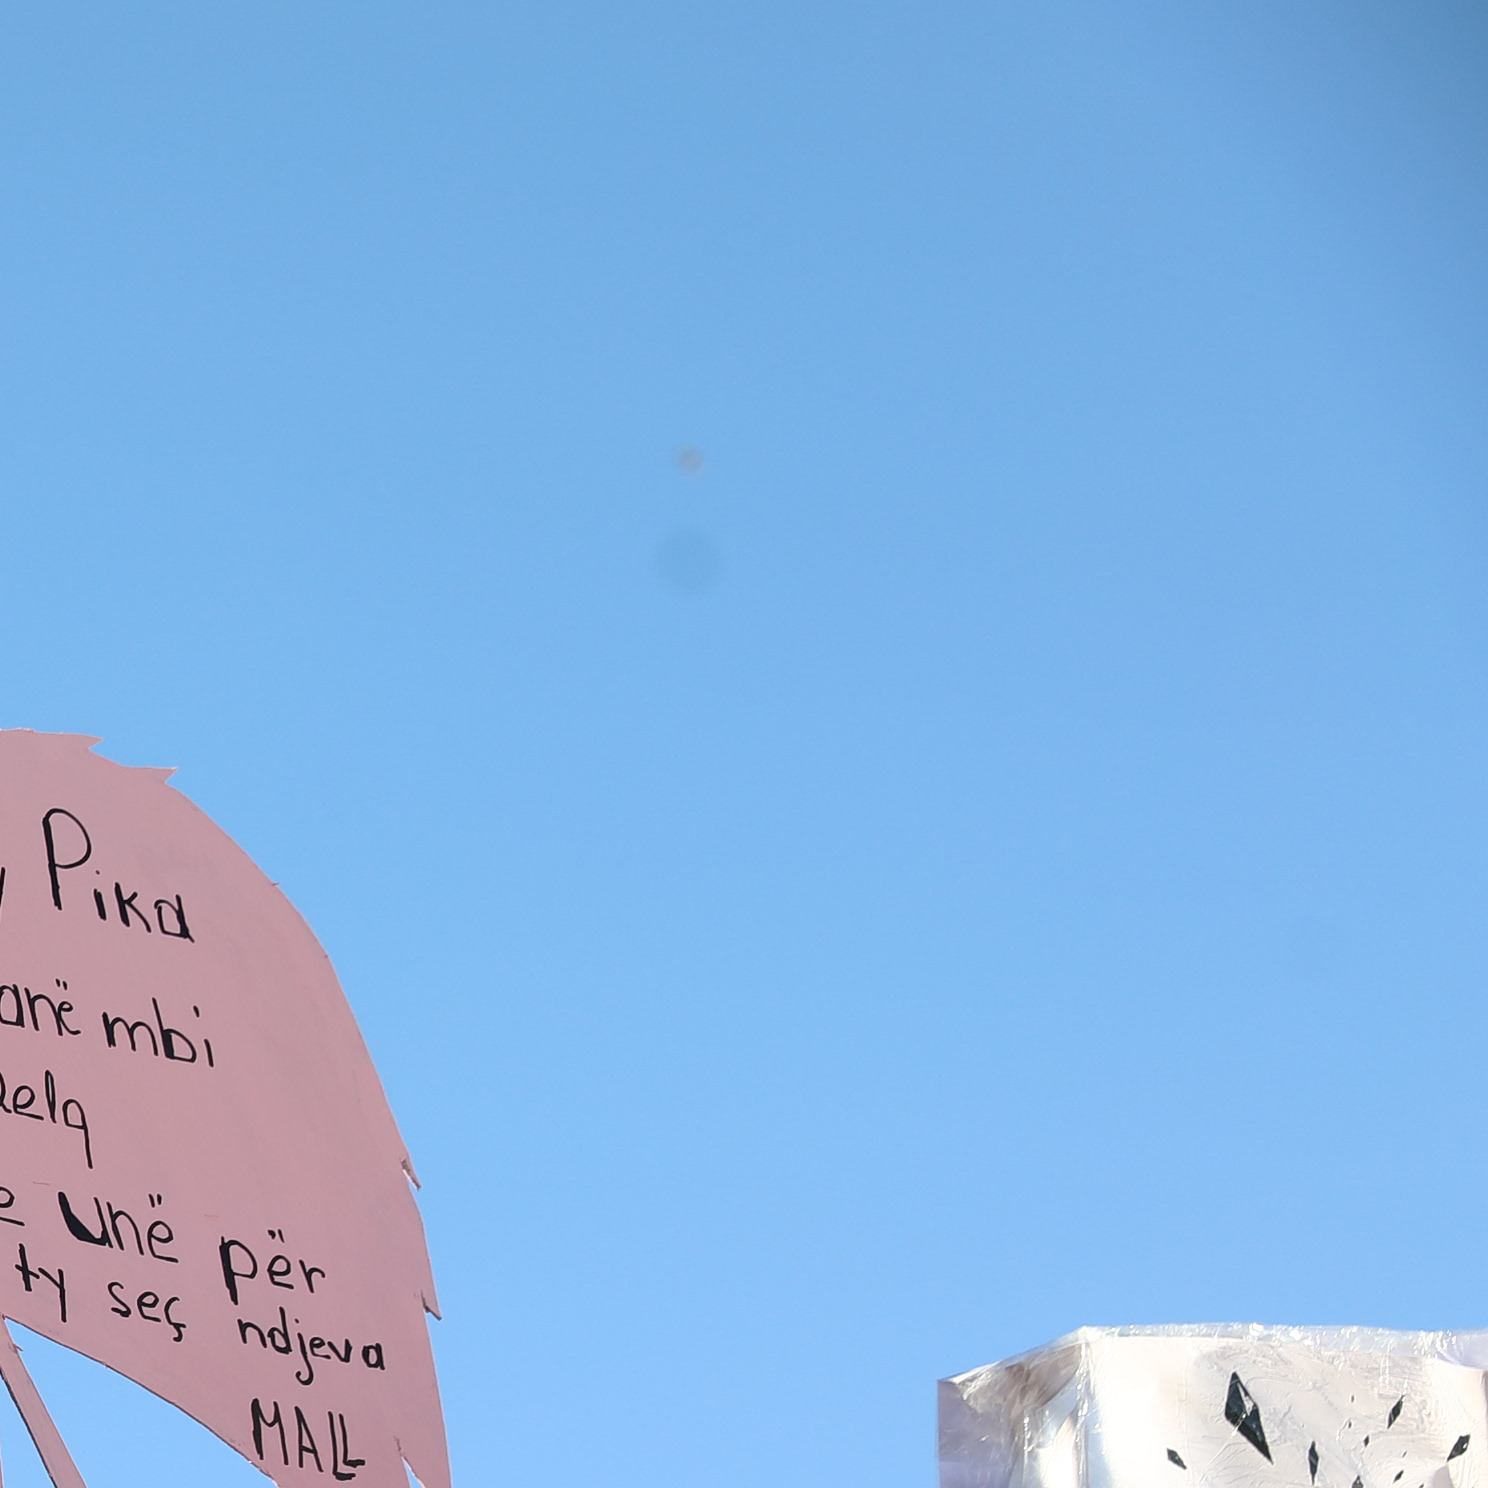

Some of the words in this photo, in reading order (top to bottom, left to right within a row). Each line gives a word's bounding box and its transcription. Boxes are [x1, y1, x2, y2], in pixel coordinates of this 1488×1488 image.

[42, 808, 194, 942] Pika
[102, 998, 214, 1067] mbi
[219, 1229, 325, 1305] për
[15, 1243, 67, 1323] ty
[108, 1282, 186, 1342] seç
[237, 1307, 385, 1385] ndjeva
[250, 1397, 366, 1481] MALL
